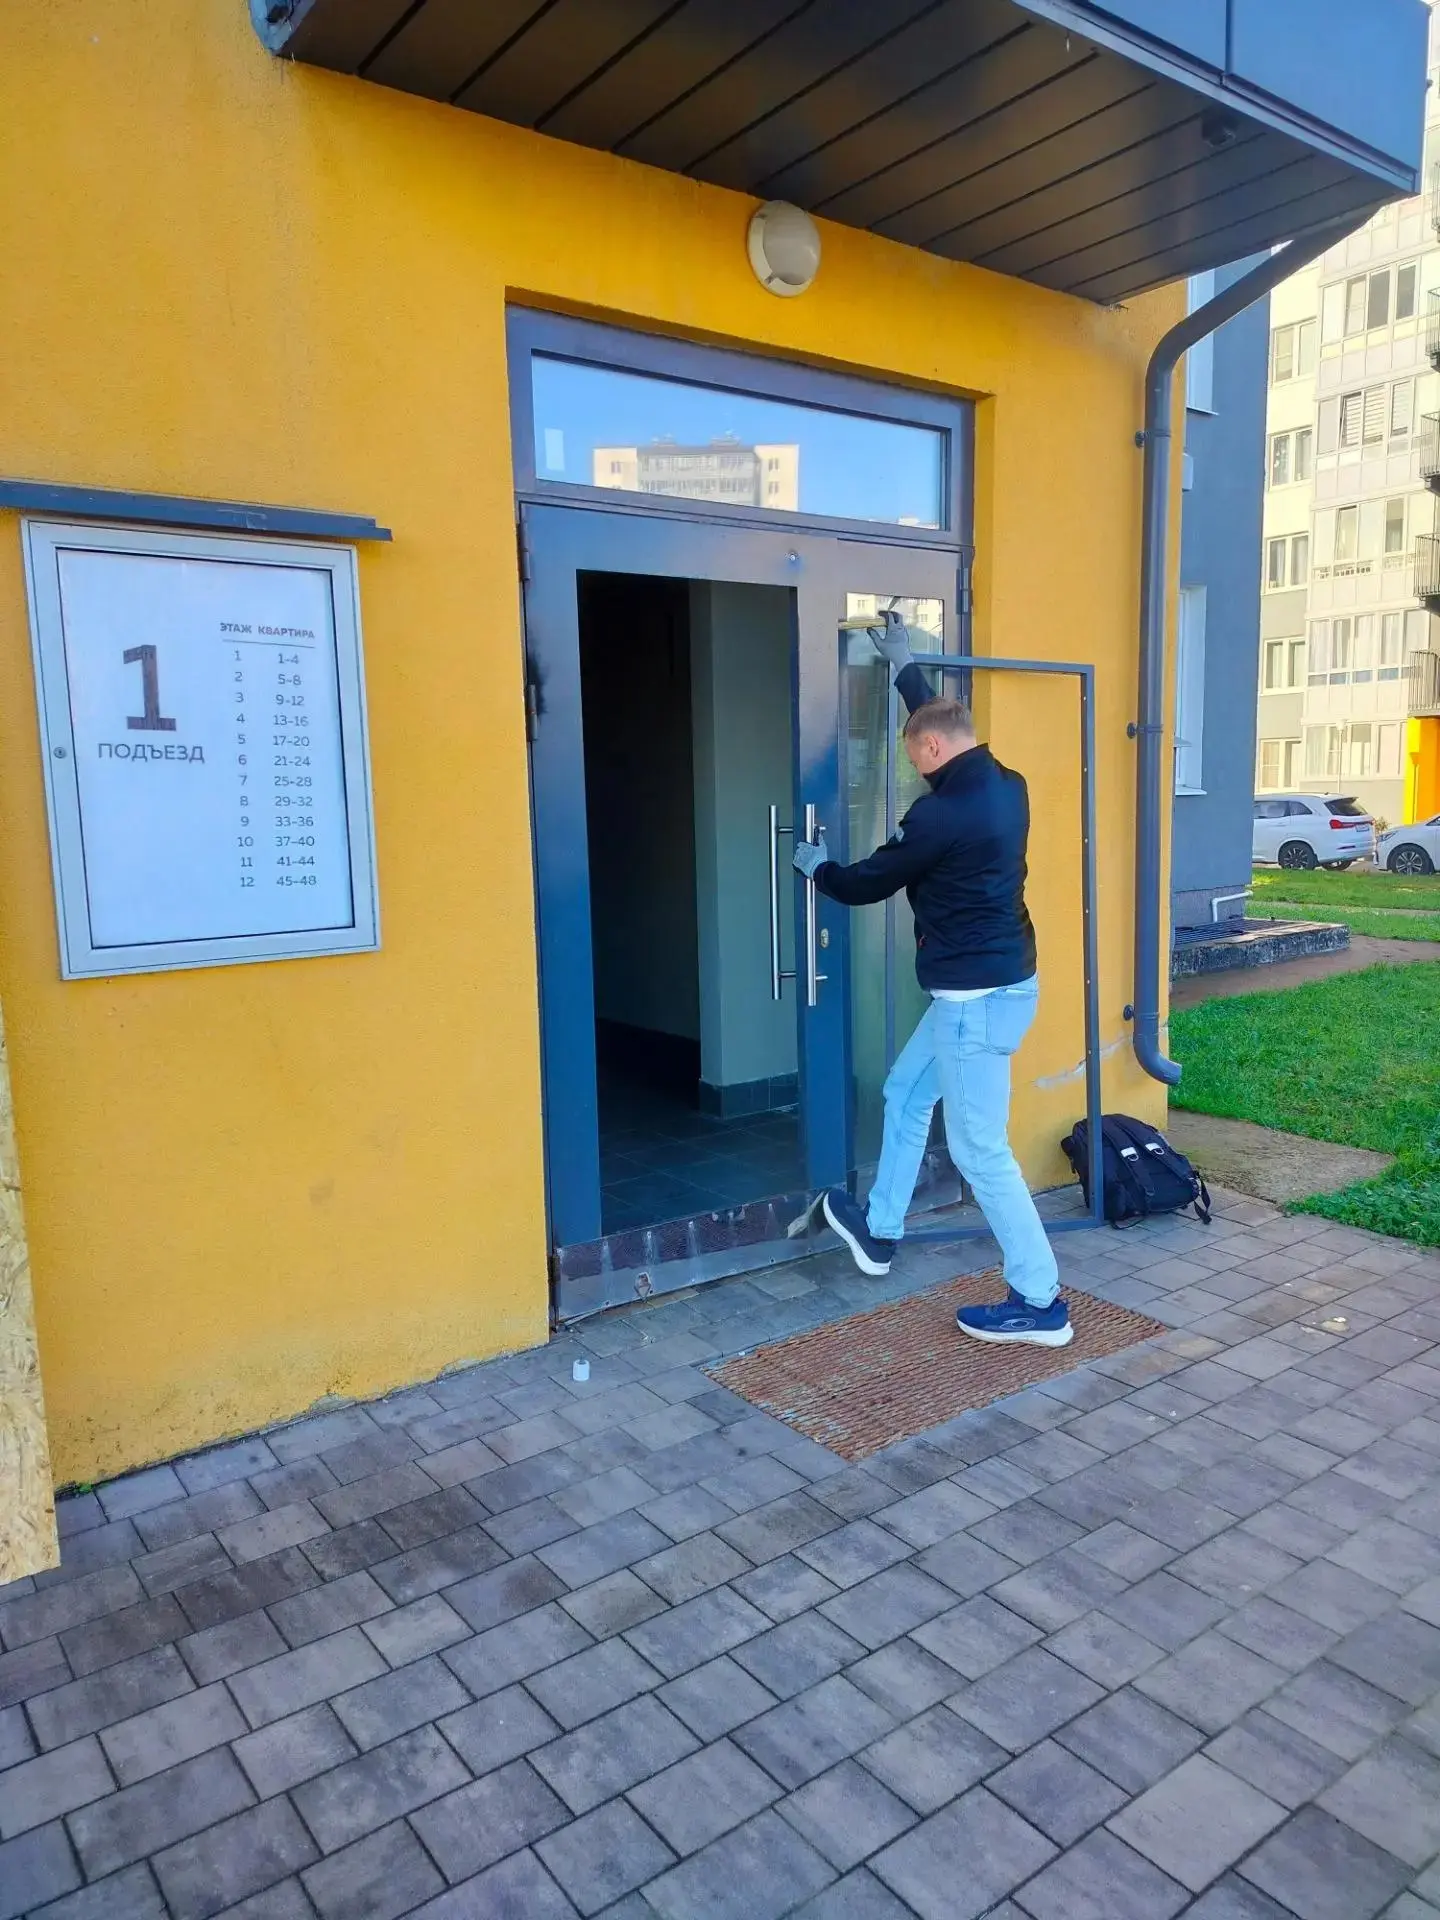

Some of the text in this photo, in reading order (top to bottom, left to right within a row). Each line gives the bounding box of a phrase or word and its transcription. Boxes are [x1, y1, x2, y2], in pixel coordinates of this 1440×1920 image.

[219, 622, 316, 640] ЭТАЖ КВАРТИРА
[233, 650, 300, 665] 1 1-4
[233, 671, 302, 686] 2 5-8
[122, 644, 177, 732] 1
[234, 692, 305, 706] 3 9-12
[236, 713, 309, 727] 4 13-16
[237, 734, 310, 748] 5 17-20
[98, 743, 205, 764] ПОДЪЕЗД
[237, 754, 312, 767] 6 21-24
[238, 775, 313, 788] 7 25-28
[239, 795, 313, 808] 8 29-32
[240, 815, 314, 828] 9 33-36
[237, 835, 316, 848] 10 37-40
[240, 855, 316, 868] 11 41-44
[240, 875, 317, 888] 12 45-48
